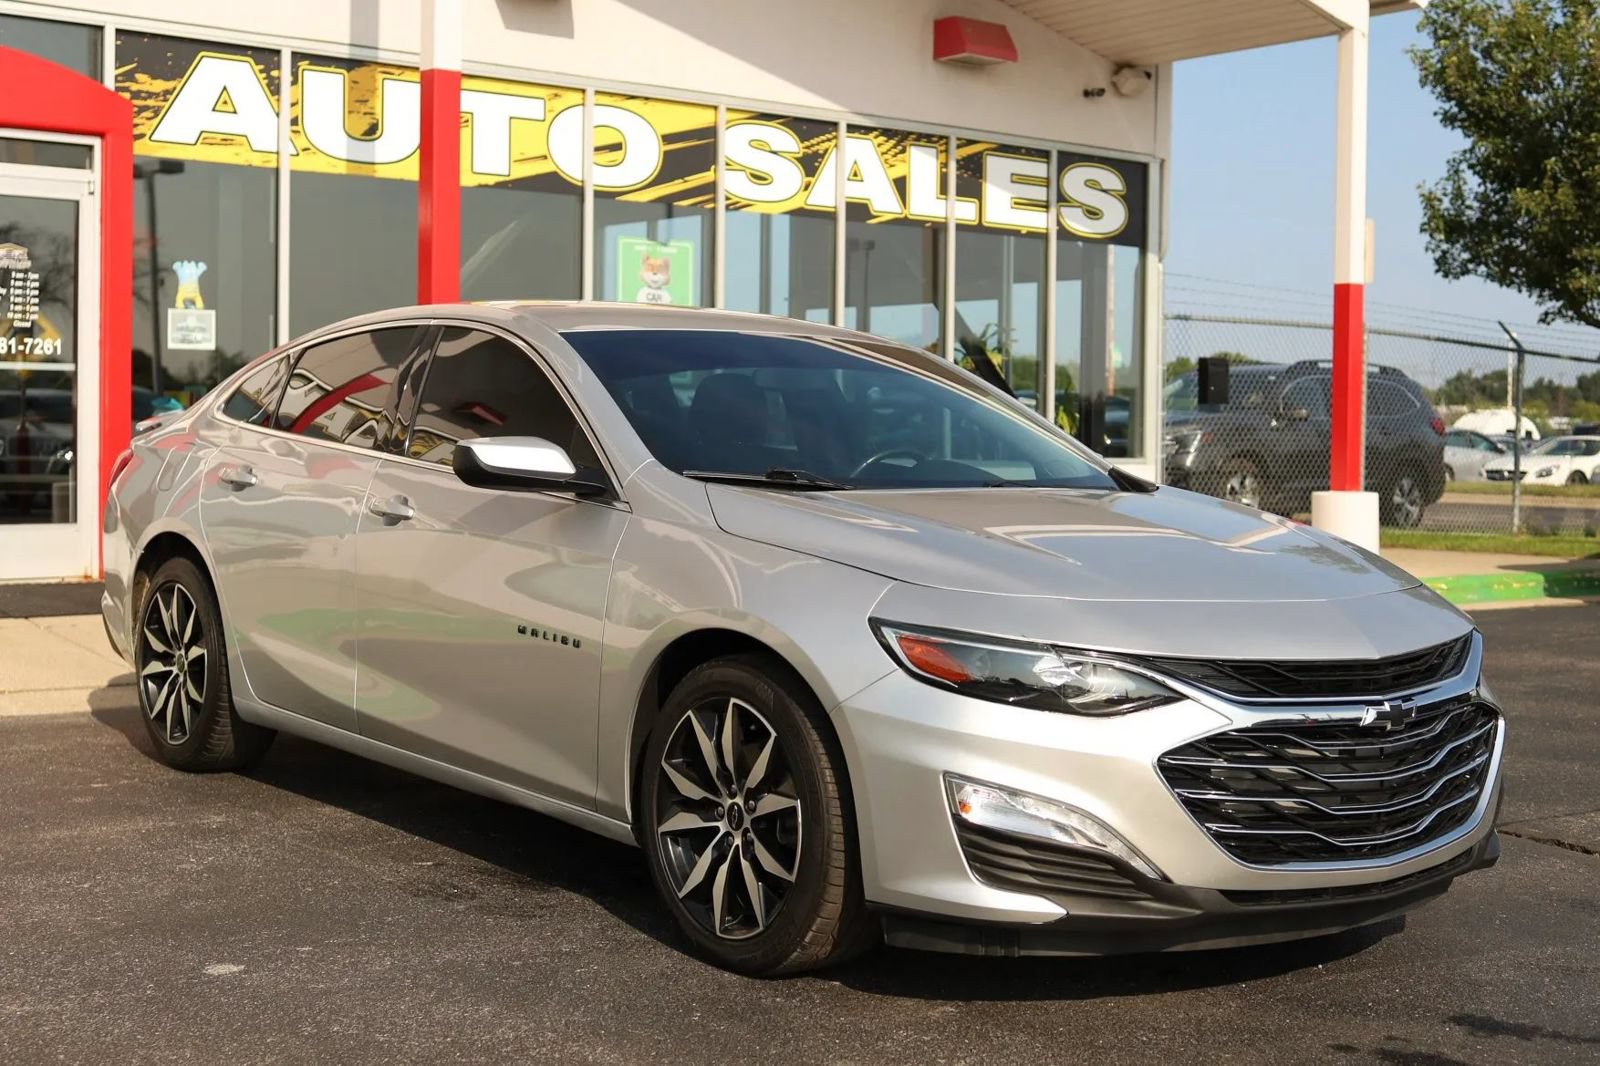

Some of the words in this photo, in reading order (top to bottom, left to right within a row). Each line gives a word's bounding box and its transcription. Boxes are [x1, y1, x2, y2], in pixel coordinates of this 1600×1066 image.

[148, 53, 663, 191] AUTO
[722, 121, 1129, 238] SALES
[517, 624, 582, 649] MALIBU
